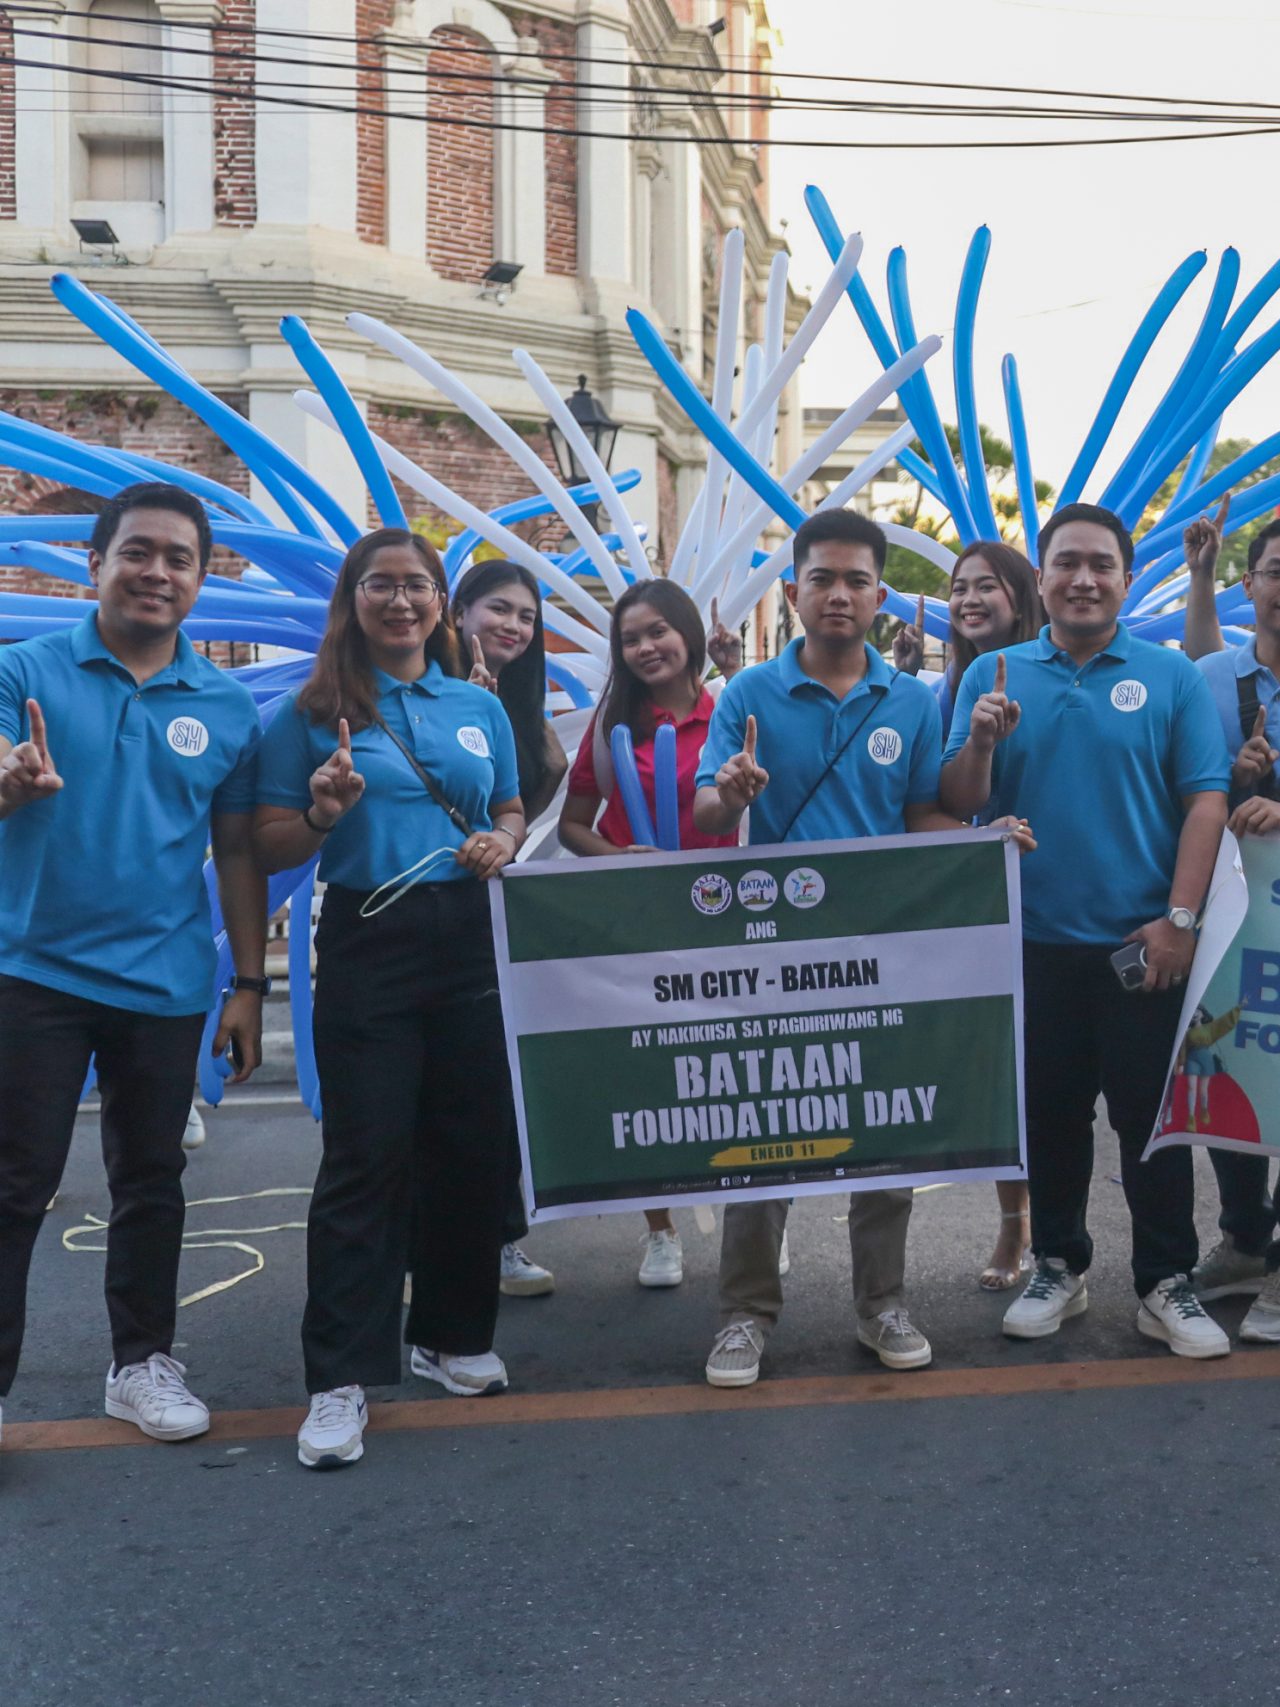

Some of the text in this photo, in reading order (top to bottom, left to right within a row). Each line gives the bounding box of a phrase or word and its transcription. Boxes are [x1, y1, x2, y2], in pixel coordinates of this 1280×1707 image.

[1114, 683, 1142, 707] SM
[171, 721, 203, 752] SM
[872, 732, 898, 760] SM
[740, 878, 775, 892] BATAAN
[745, 920, 778, 940] ANG
[653, 973, 695, 1002] SM
[700, 967, 760, 998] CITY
[781, 958, 880, 992] BATAAN
[631, 1008, 904, 1048] AY NAKIKIISA SA PAGDIRIWANG NG
[673, 1041, 863, 1099] BATAAN
[611, 1085, 938, 1149] FOUNDATION DAY
[751, 1142, 815, 1161] ENERO 11
